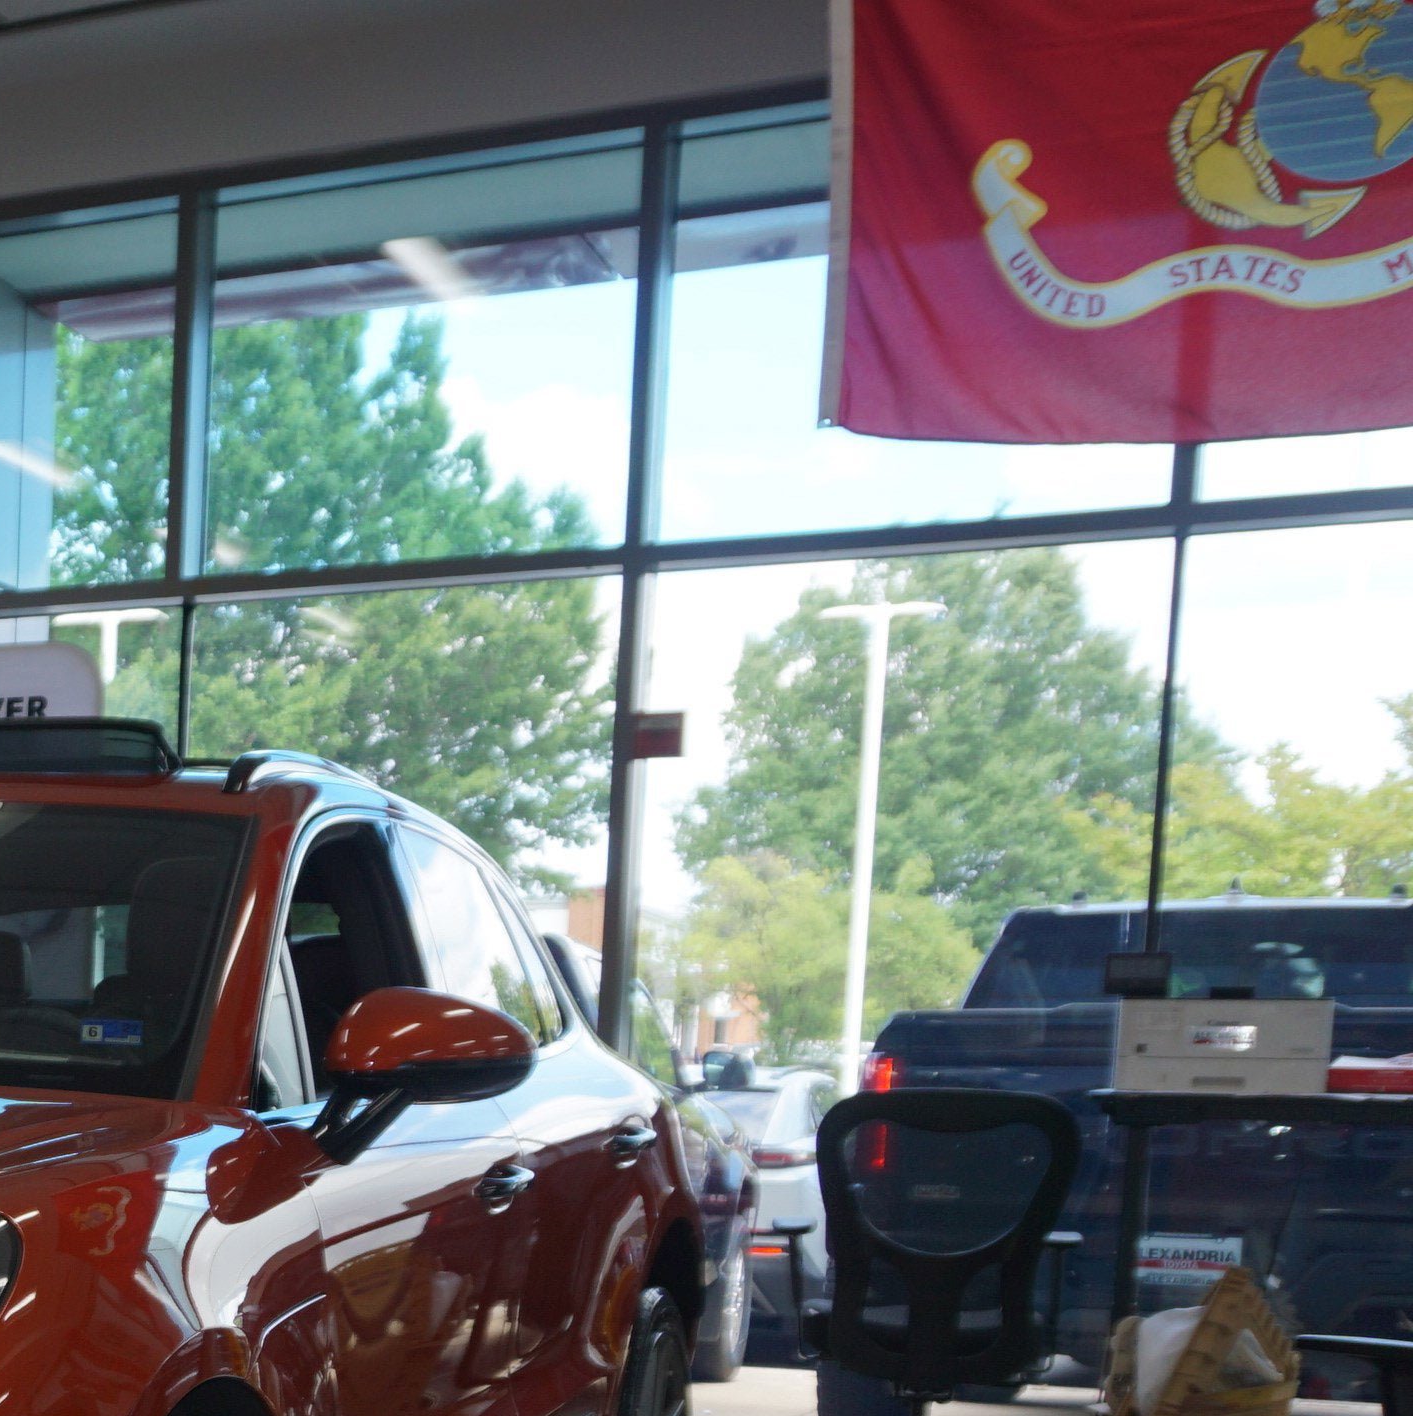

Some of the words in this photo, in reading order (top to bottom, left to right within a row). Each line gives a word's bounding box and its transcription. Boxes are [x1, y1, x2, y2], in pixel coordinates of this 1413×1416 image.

[1009, 249, 1106, 318] UNITED
[1168, 254, 1307, 294] STATES
[88, 1026, 99, 1038] 6
